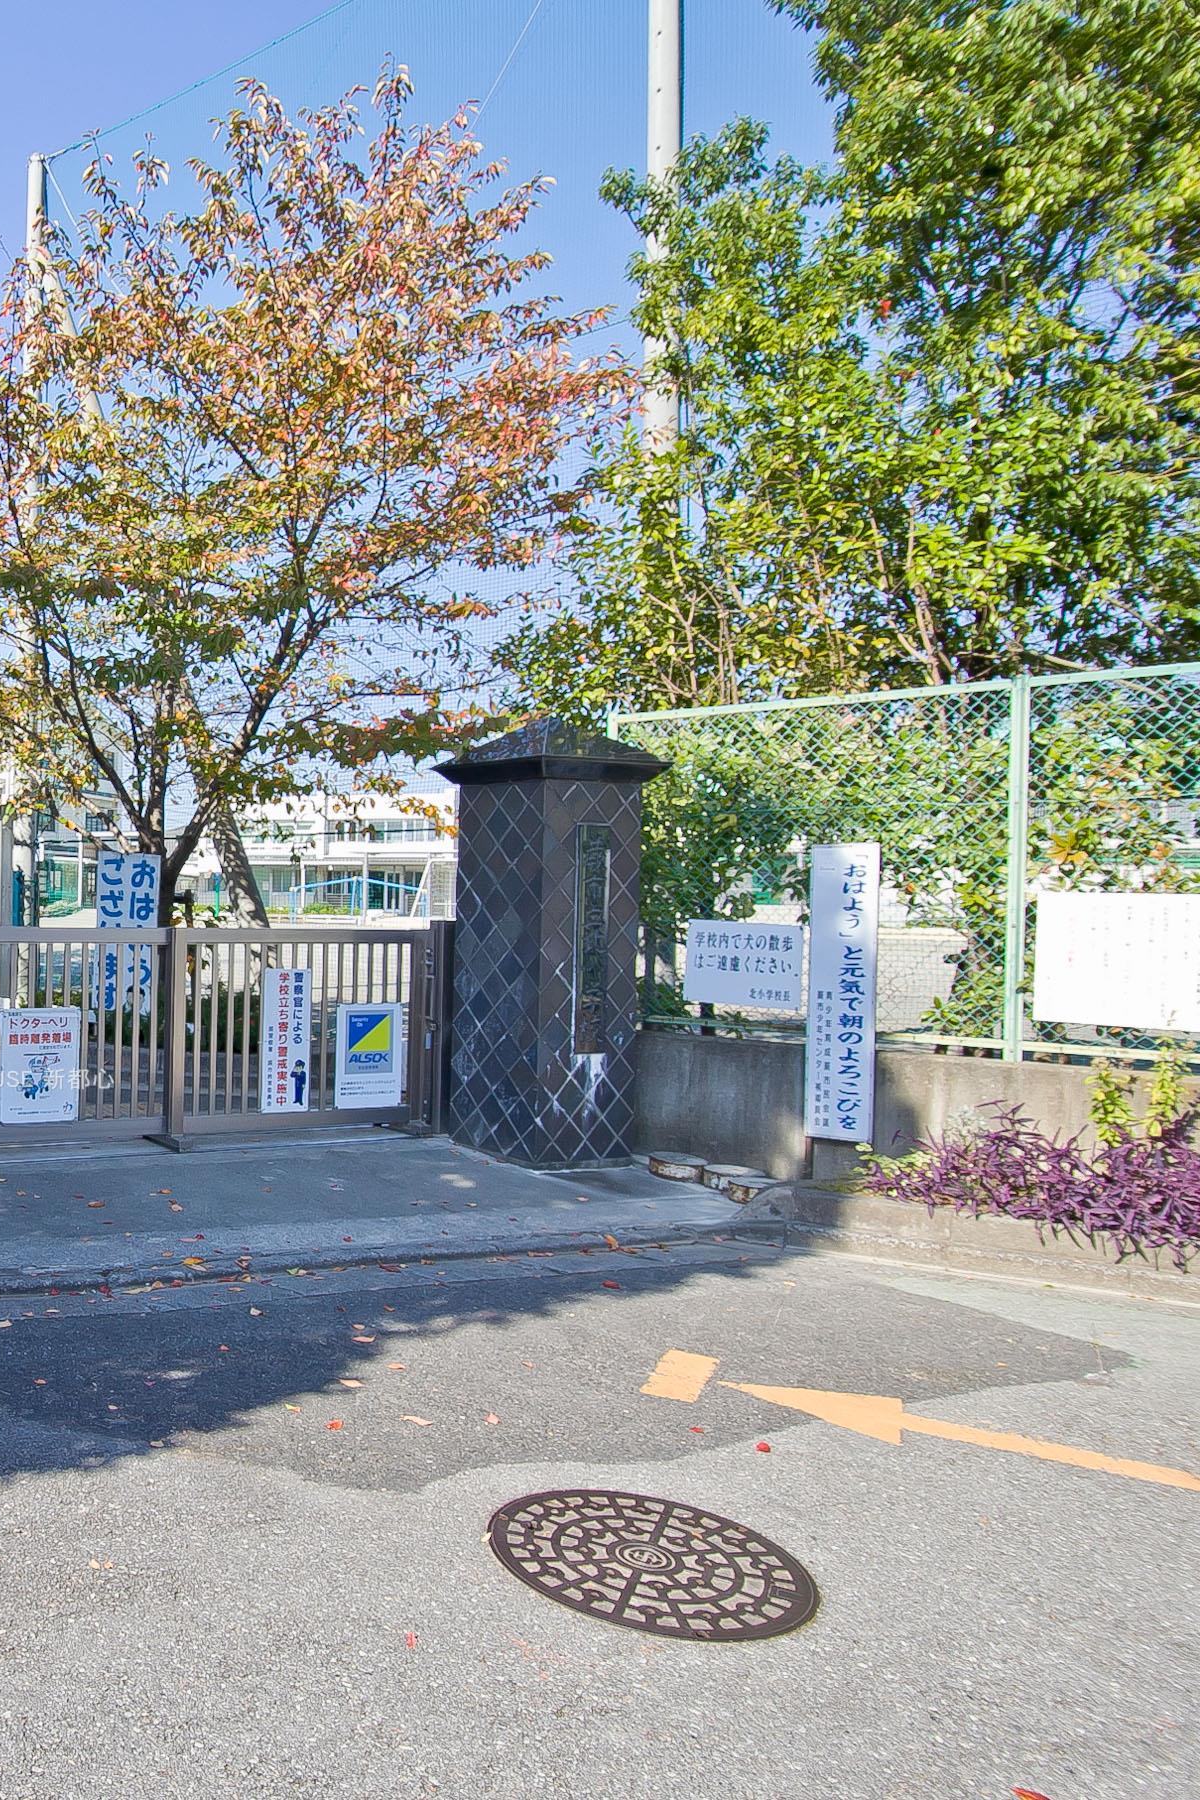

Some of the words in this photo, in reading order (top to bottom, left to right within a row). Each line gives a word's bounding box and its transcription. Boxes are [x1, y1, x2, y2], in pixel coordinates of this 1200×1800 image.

[128, 859, 156, 985] おはう
[695, 931, 793, 952] 学校内で犬の散歩
[10, 1017, 68, 1029] ドクターヘリ
[292, 972, 304, 1044] 警察官による
[276, 972, 290, 1106] 学校立ち寄り警戒実施中
[349, 1053, 389, 1064] ALSOK
